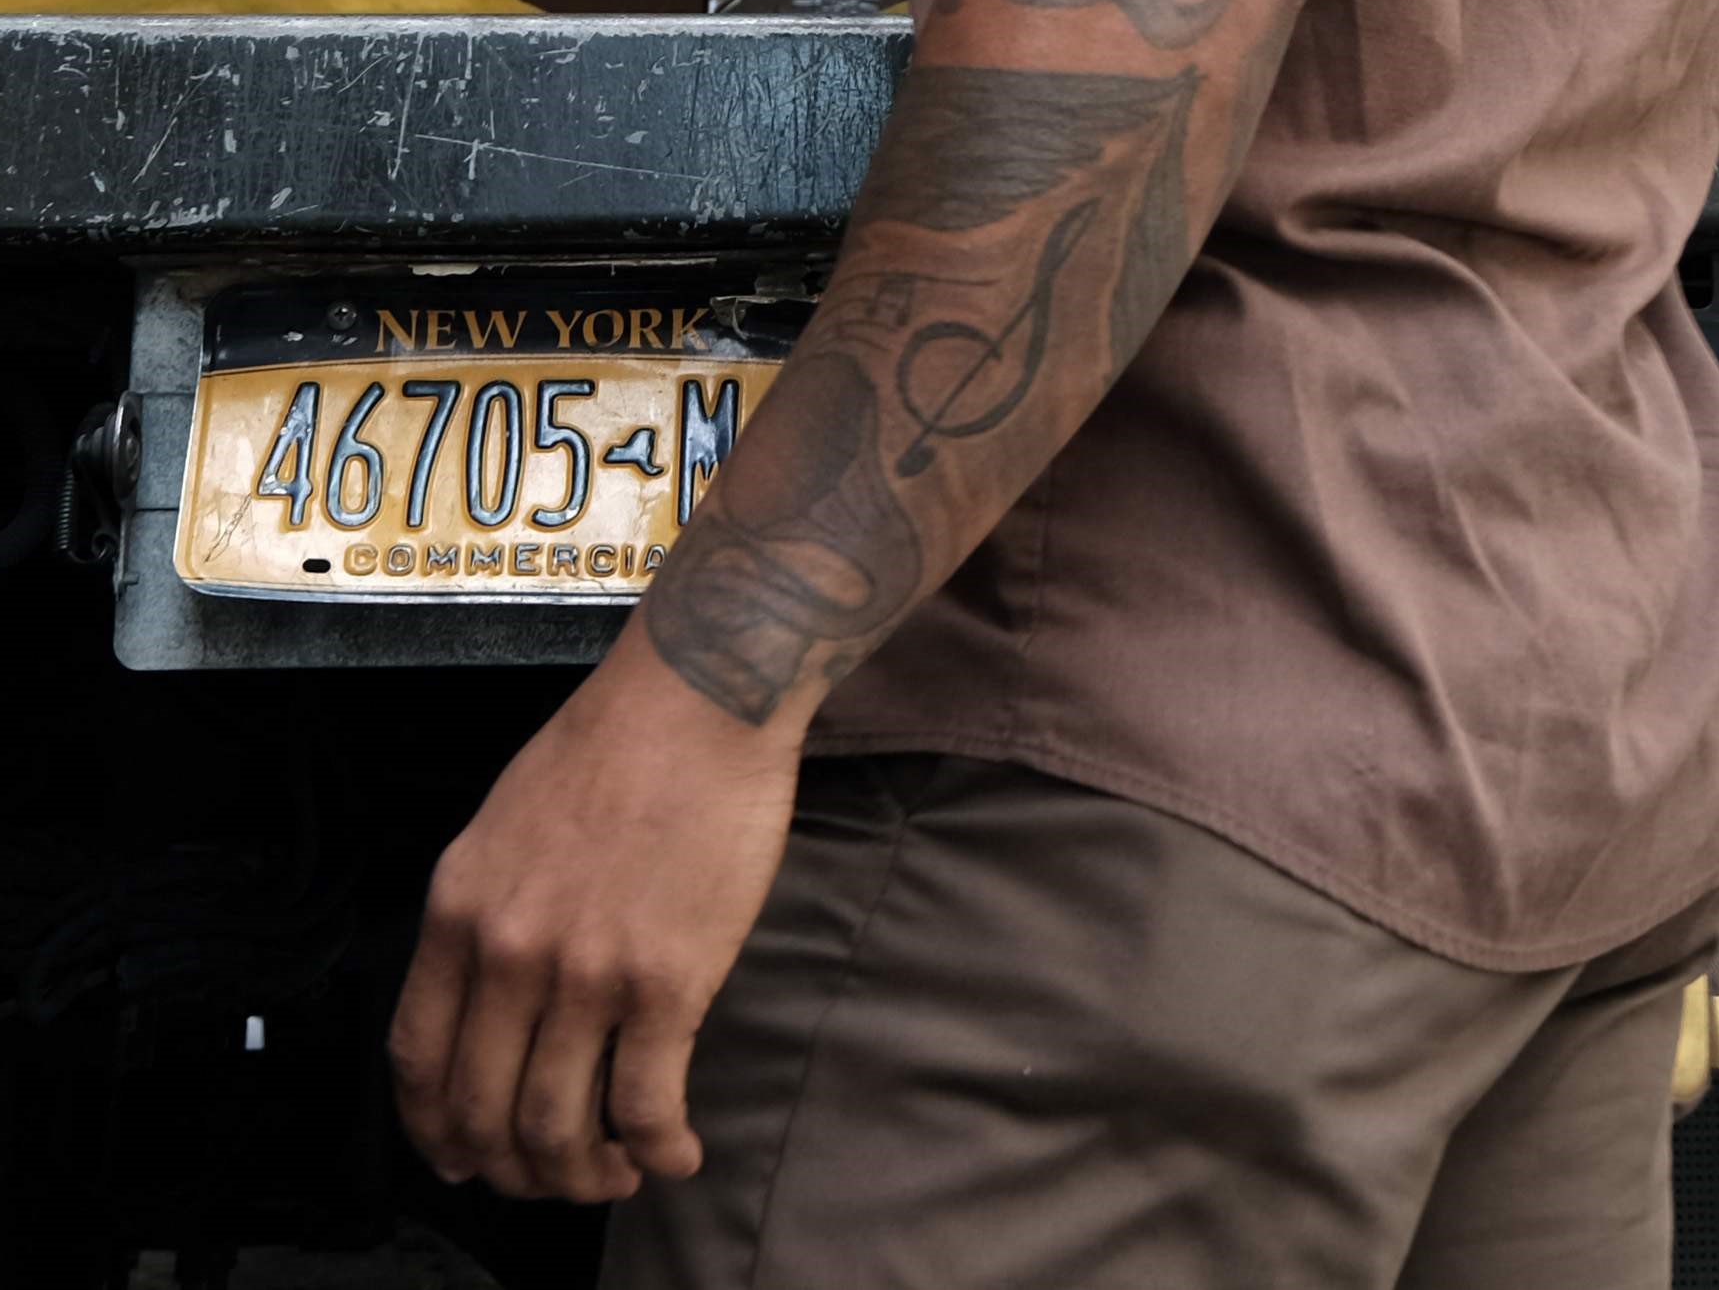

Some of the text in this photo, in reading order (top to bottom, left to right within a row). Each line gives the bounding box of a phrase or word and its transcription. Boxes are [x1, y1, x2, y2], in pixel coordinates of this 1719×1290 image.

[373, 307, 711, 353] NEW YORK
[258, 378, 596, 529] 46705
[345, 542, 668, 578] COMMERCIA
